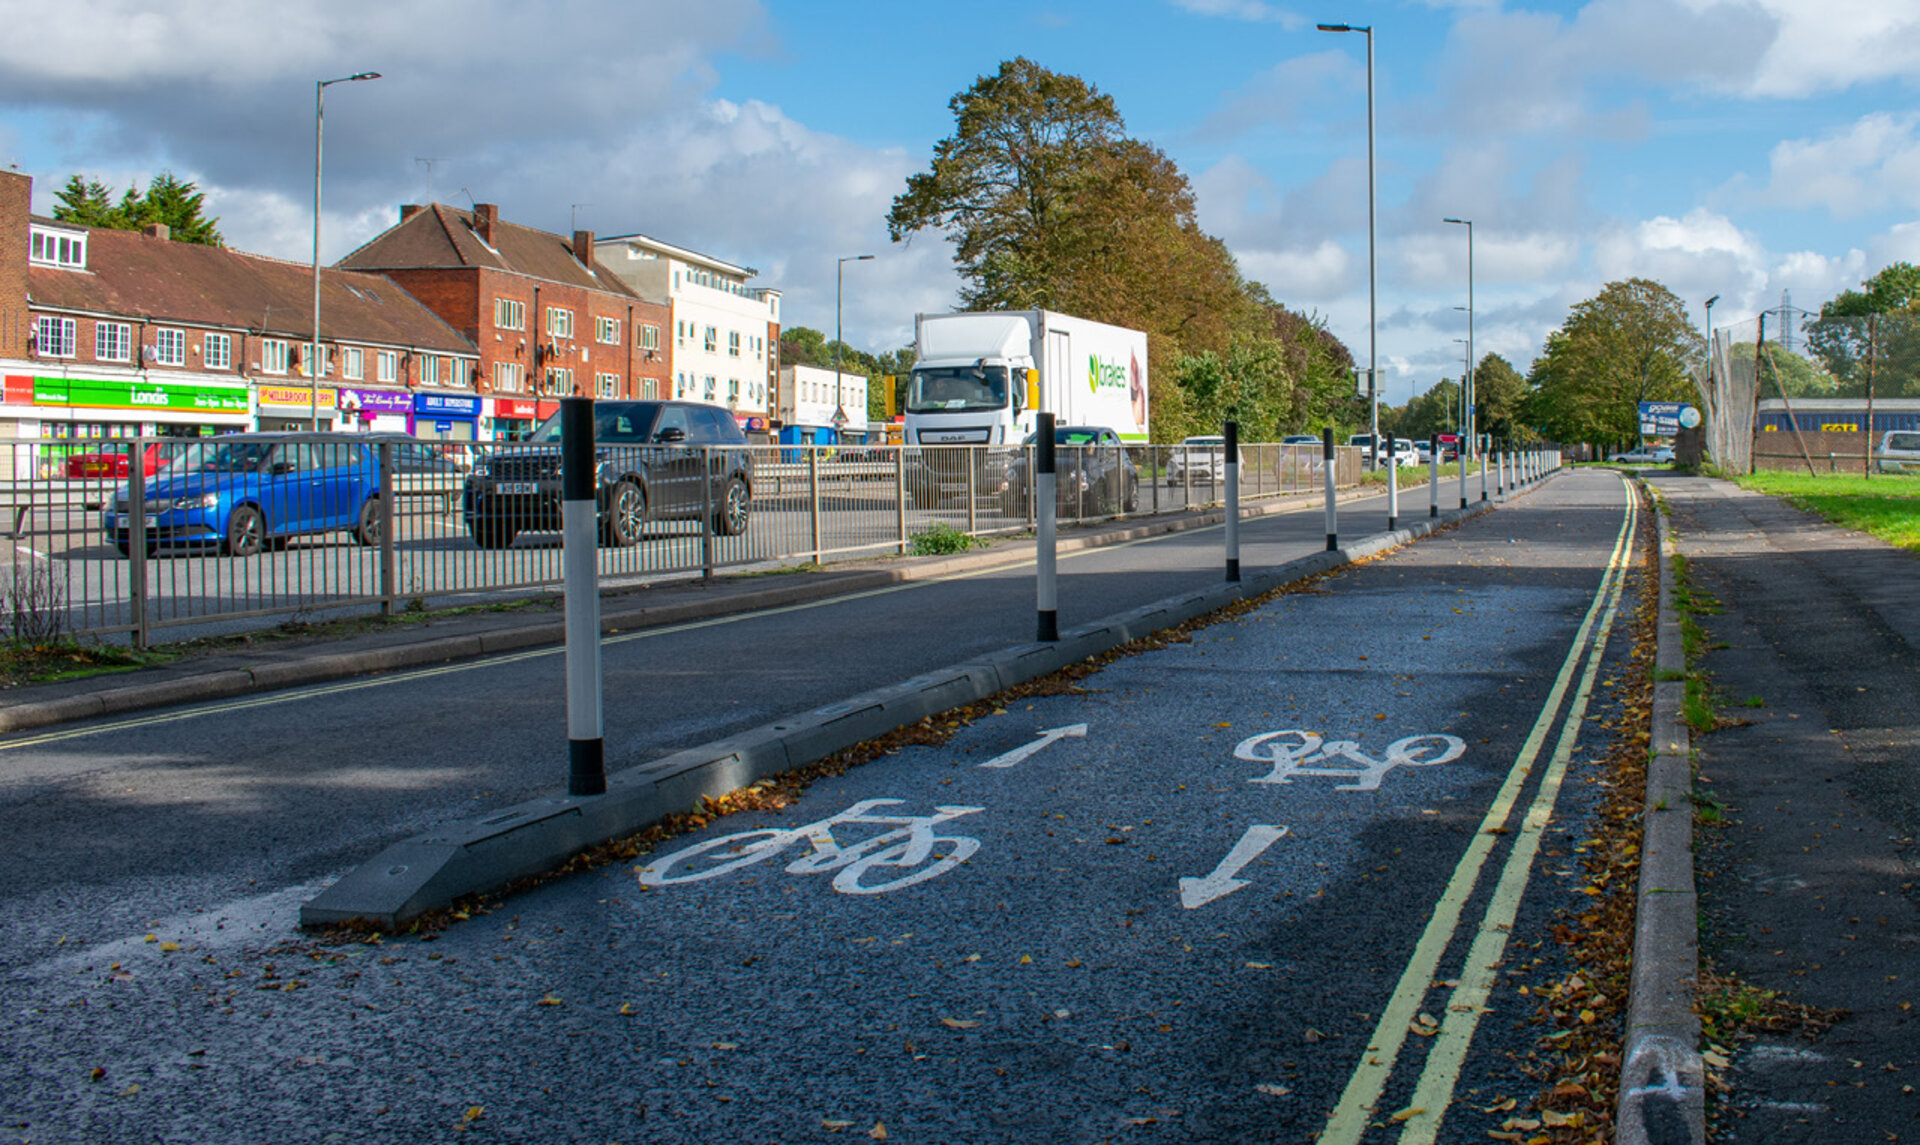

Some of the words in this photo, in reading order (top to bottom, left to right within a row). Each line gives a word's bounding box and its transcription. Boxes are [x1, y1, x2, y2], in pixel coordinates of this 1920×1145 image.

[1099, 355, 1126, 388] brakes
[131, 386, 169, 405] Londis
[269, 390, 308, 402] MILLBROOK
